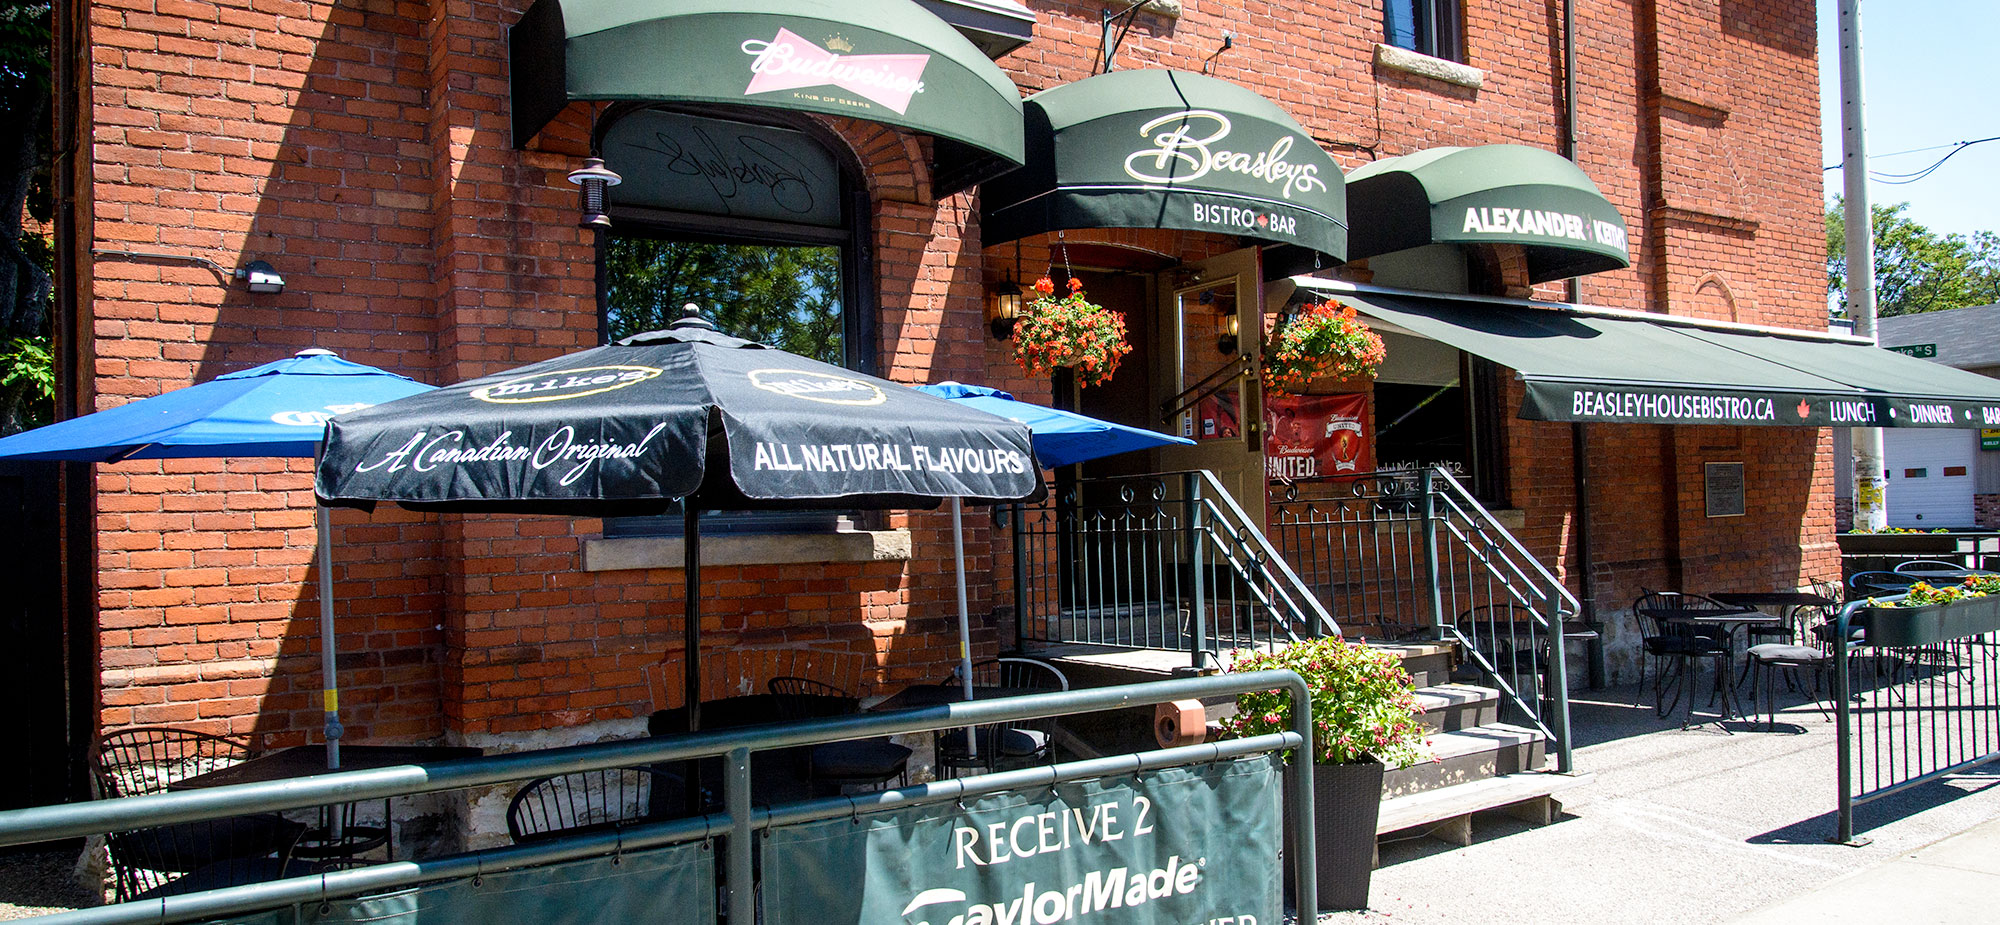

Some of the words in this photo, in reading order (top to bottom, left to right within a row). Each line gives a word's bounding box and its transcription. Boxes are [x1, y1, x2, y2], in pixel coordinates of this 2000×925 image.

[741, 39, 925, 94] Budweiser
[1125, 109, 1327, 198] Beasleys
[1193, 203, 1255, 228] BISTRO
[1270, 213, 1296, 236] BAR
[1462, 207, 1586, 241] ALEXANDER
[1924, 345, 1933, 356] S
[1572, 390, 1775, 420] BEASLEYHOUSEBISTRO.CA
[1829, 401, 1876, 422] LUNCH
[1909, 404, 1955, 424] DINNER
[355, 431, 427, 473] A
[413, 430, 532, 473] Canadian
[531, 422, 668, 487] Original
[754, 442, 802, 471] ALL
[801, 443, 912, 472] NATURAL
[911, 446, 1025, 474] FLAVOURS
[1278, 445, 1315, 454] Budweiser
[954, 800, 1124, 870] RECEIVE
[1133, 796, 1155, 837] 2
